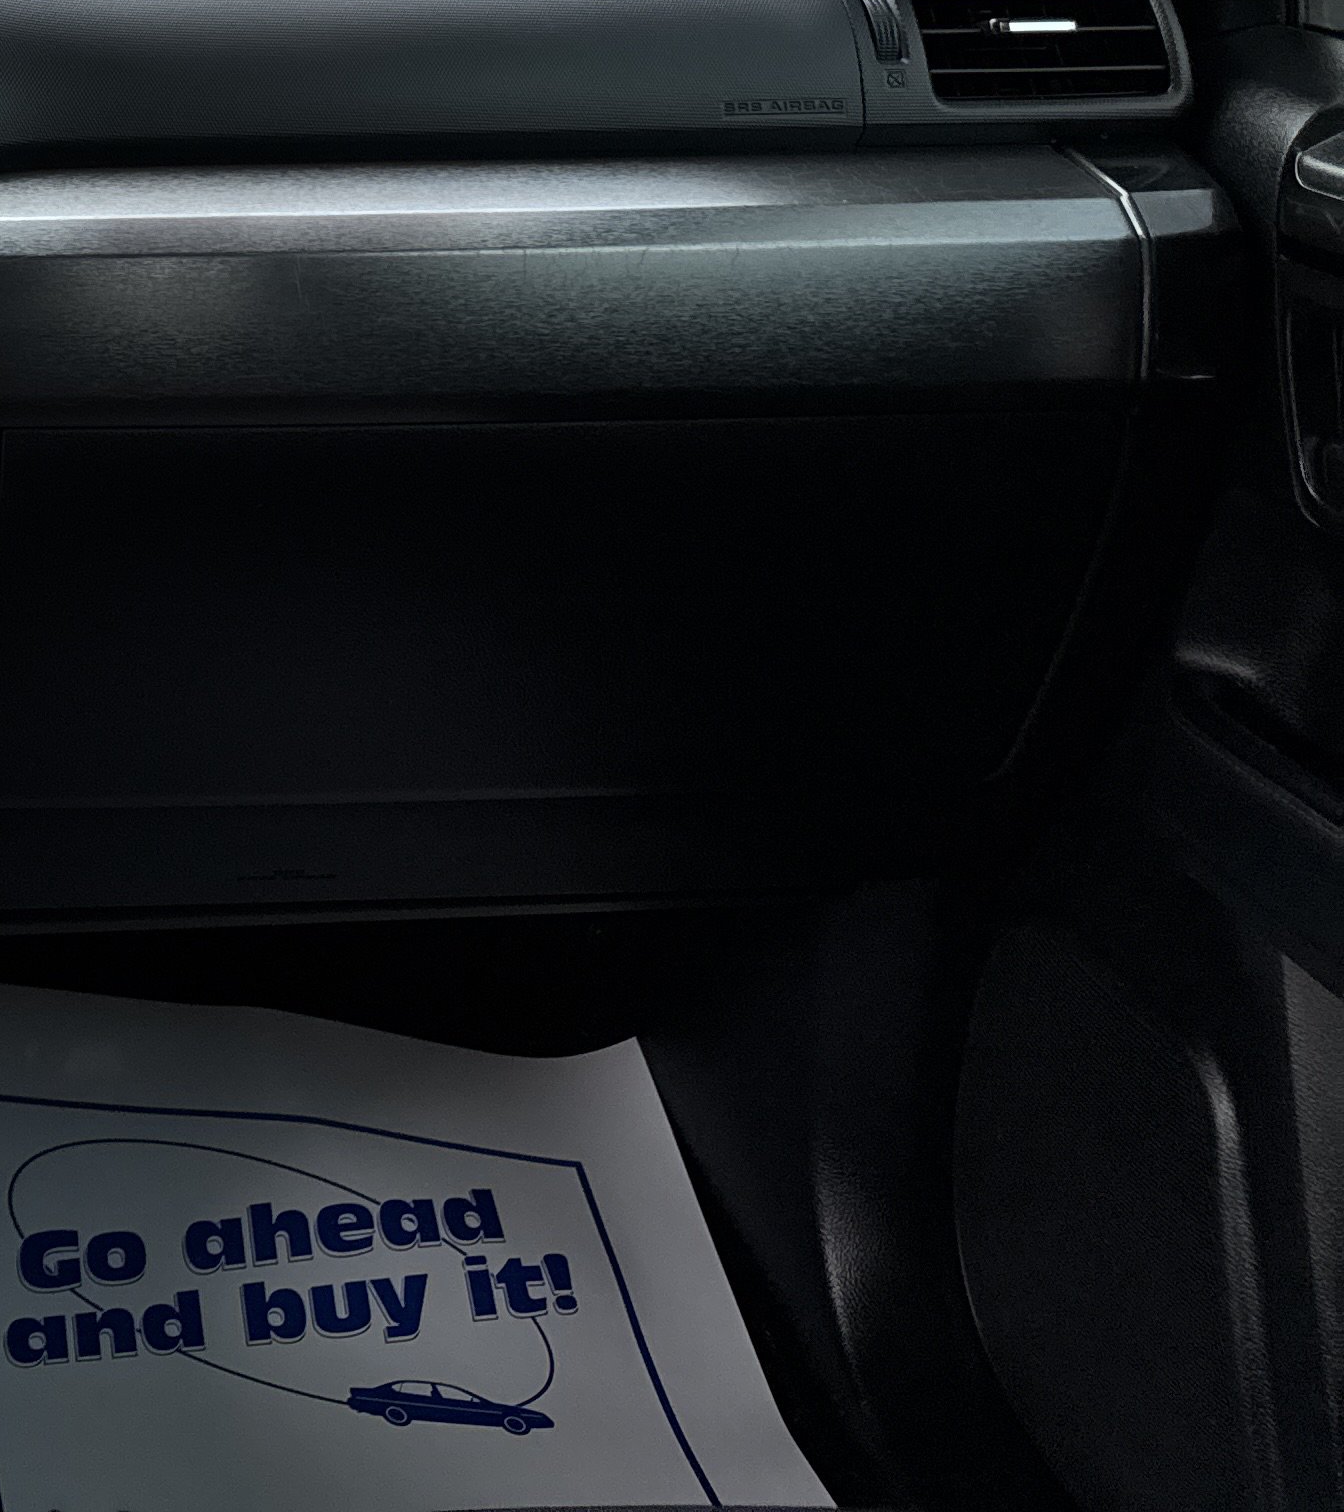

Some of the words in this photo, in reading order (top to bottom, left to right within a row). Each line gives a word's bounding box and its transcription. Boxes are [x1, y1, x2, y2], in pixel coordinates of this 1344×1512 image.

[771, 100, 845, 111] AIRBAG
[17, 1228, 148, 1293] Go
[182, 1188, 506, 1274] ahead
[4, 1289, 206, 1369] and
[242, 1272, 430, 1345] buy
[462, 1250, 579, 1322] it!
